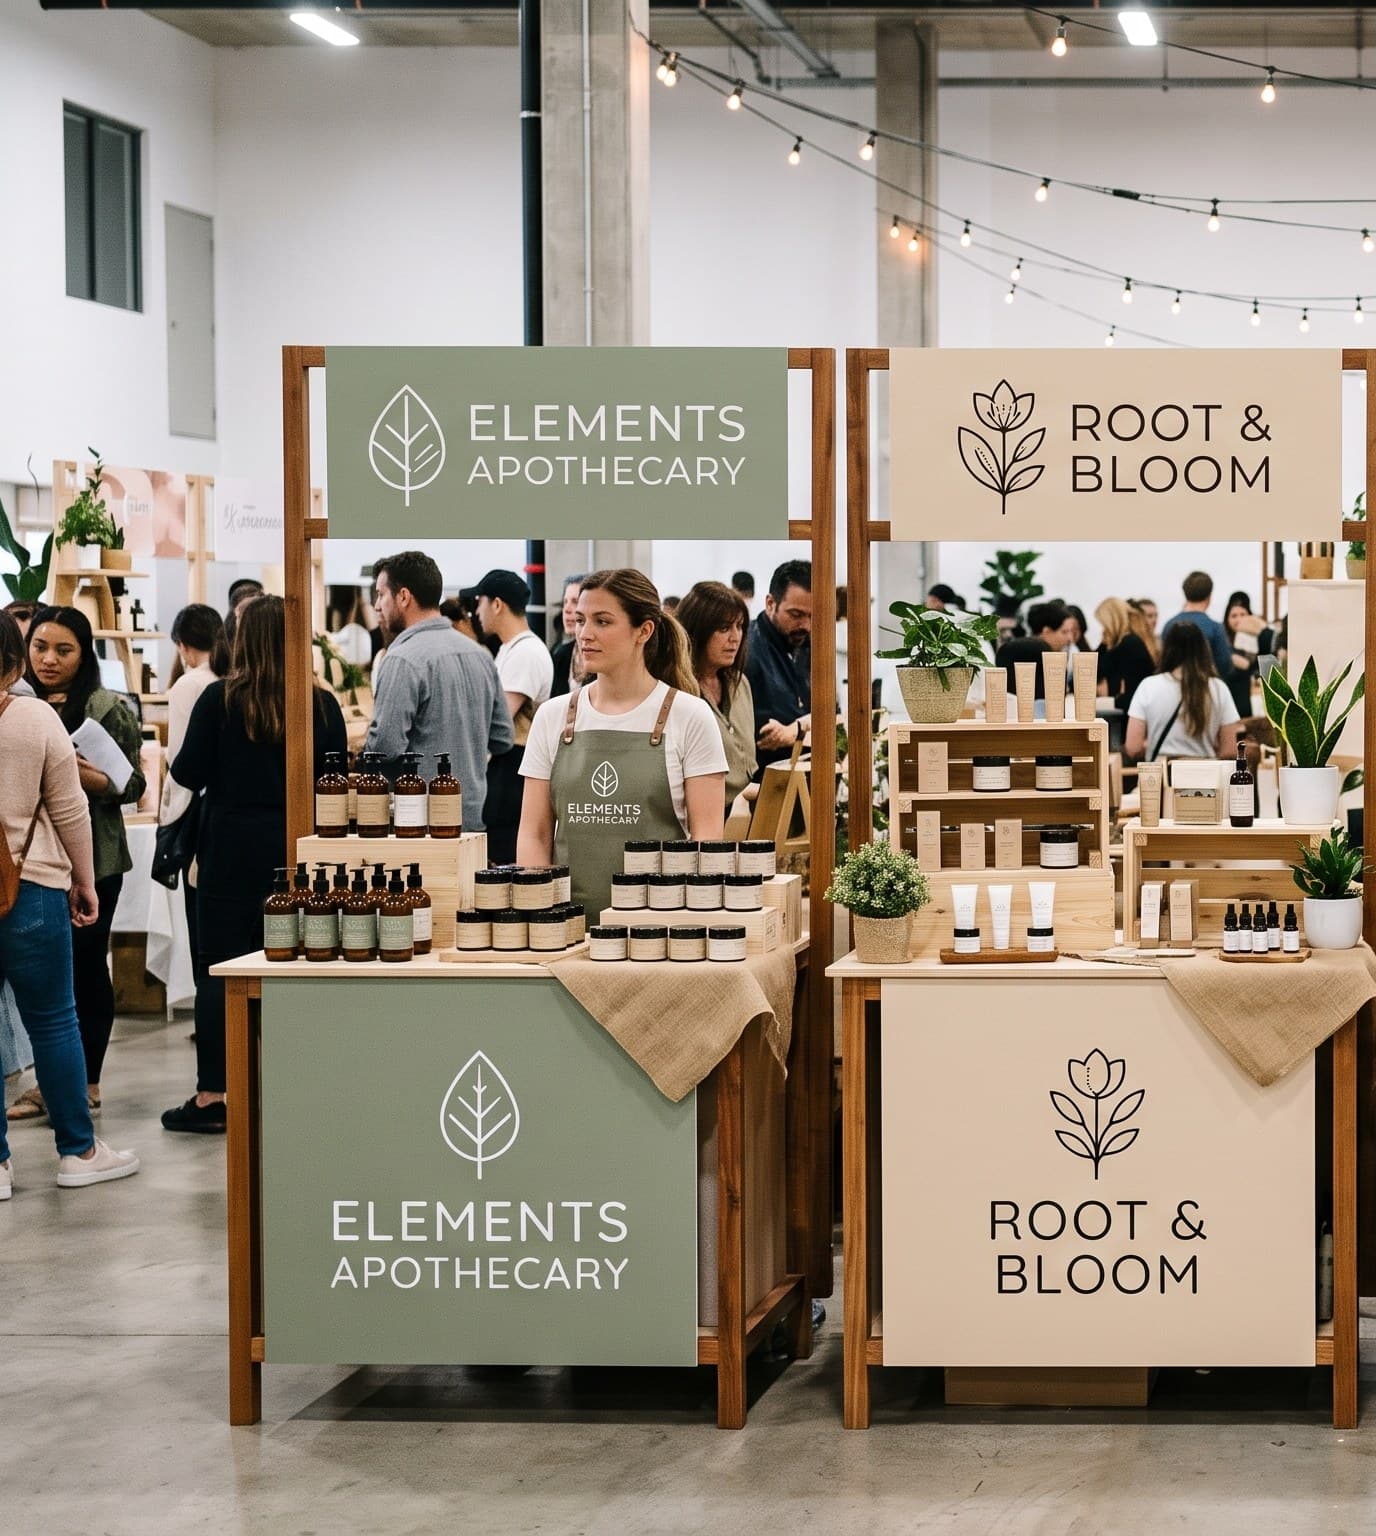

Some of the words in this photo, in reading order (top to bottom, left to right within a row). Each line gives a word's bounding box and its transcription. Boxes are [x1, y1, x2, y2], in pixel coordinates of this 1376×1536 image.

[470, 404, 746, 442] ELEMENTS
[1072, 403, 1223, 442] ROOT
[1240, 404, 1272, 442] &
[467, 455, 746, 486] APOTHECARY
[1072, 455, 1270, 494] BLOOM
[567, 803, 641, 815] ELEMENTS
[568, 815, 639, 824] APOTHECARY
[333, 1200, 628, 1243] ELEMENTS
[990, 1200, 1148, 1241] ROOT
[1171, 1199, 1208, 1241] &
[330, 1256, 629, 1290] APOTHECARY
[997, 1254, 1198, 1295] BLOOM
